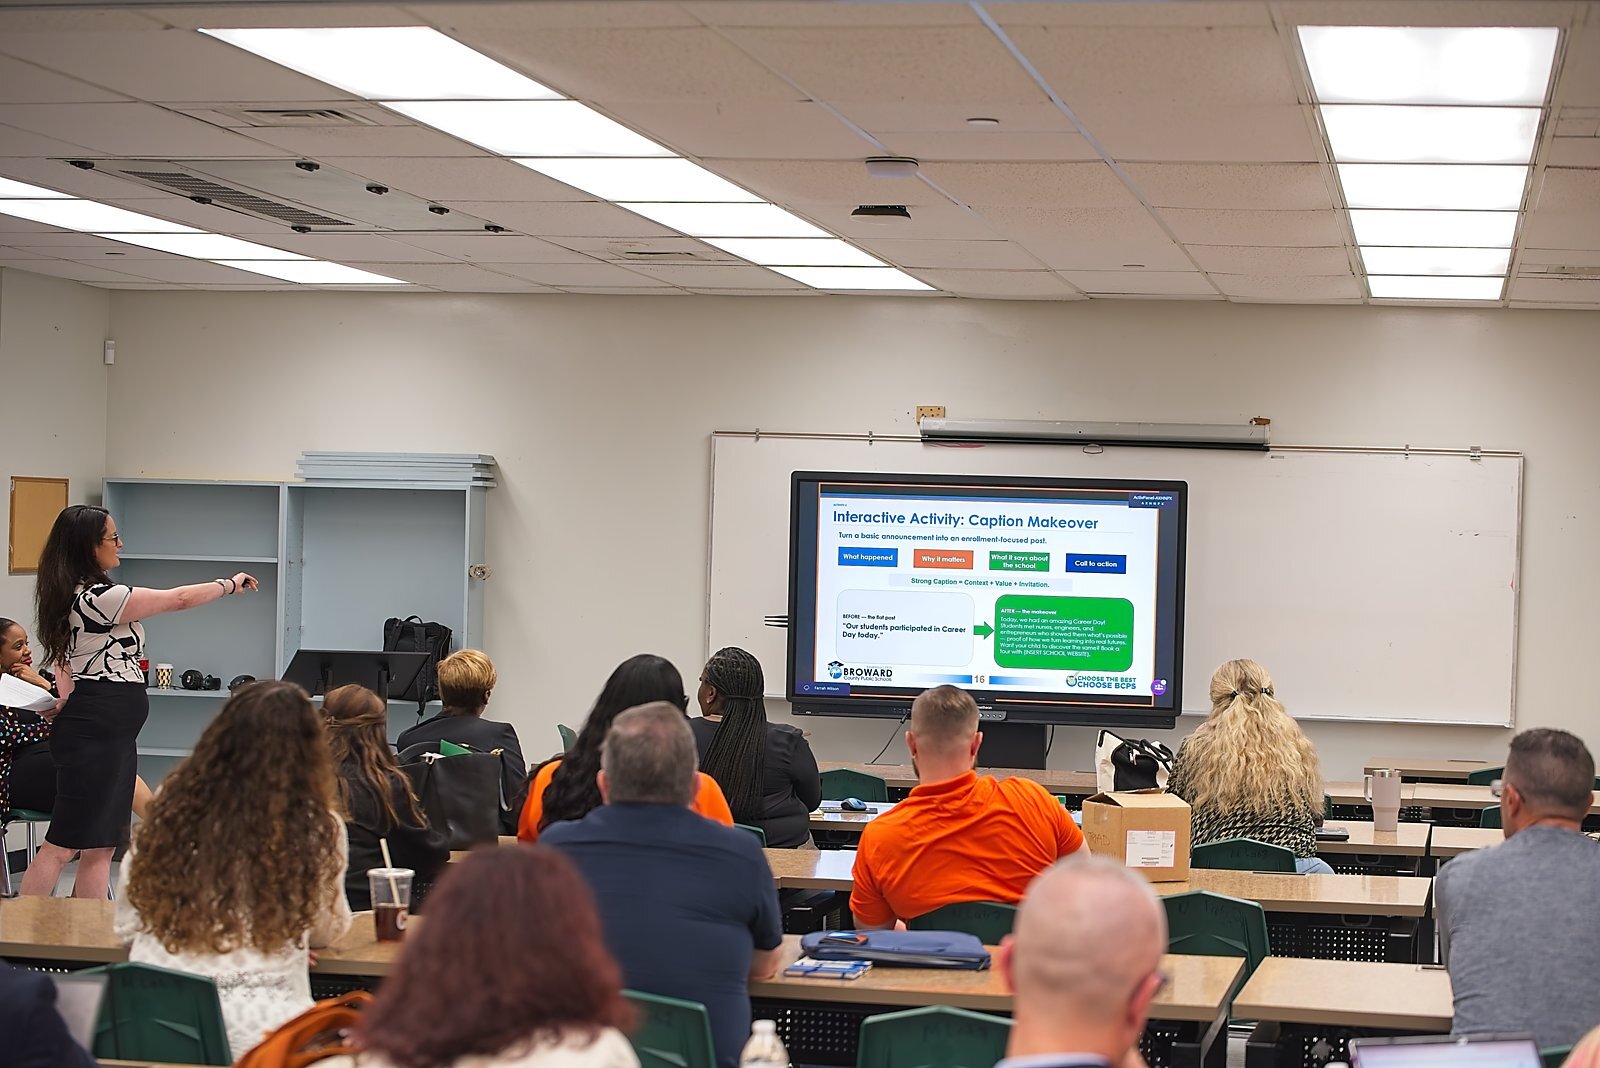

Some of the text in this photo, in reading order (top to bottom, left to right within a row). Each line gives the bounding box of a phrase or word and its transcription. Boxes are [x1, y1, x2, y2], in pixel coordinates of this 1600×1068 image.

[833, 510, 1098, 529] Interactive Activity: Caption Makeover
[961, 536, 1028, 544] enrollment-focused
[860, 554, 894, 562] happened
[911, 578, 932, 586] Strong
[933, 578, 958, 586] Caption
[860, 623, 888, 631] students
[890, 624, 932, 633] participated
[842, 631, 856, 640] Day
[844, 668, 892, 678] BROWARD
[974, 676, 985, 684] 16
